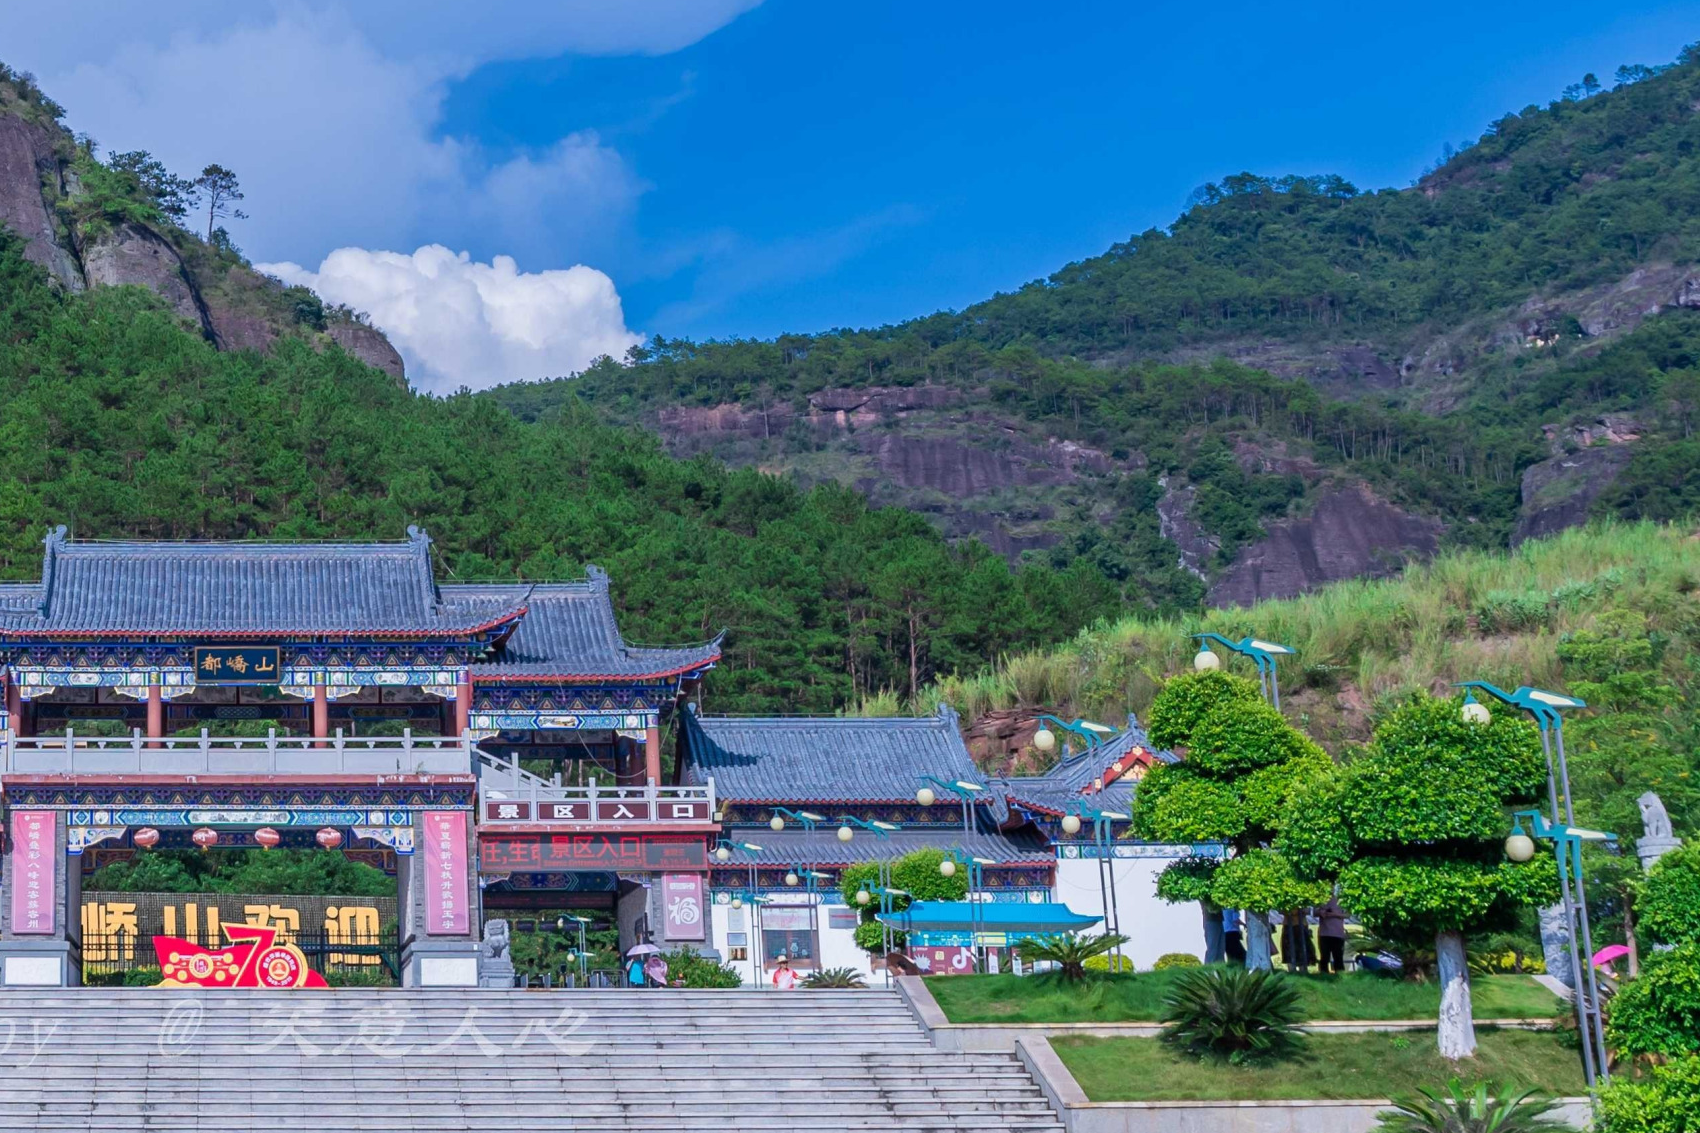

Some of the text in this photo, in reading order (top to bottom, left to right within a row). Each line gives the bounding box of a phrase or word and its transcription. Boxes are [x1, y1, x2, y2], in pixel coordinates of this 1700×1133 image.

[497, 804, 694, 819] 景区入口
[550, 835, 641, 859] 景区入口
